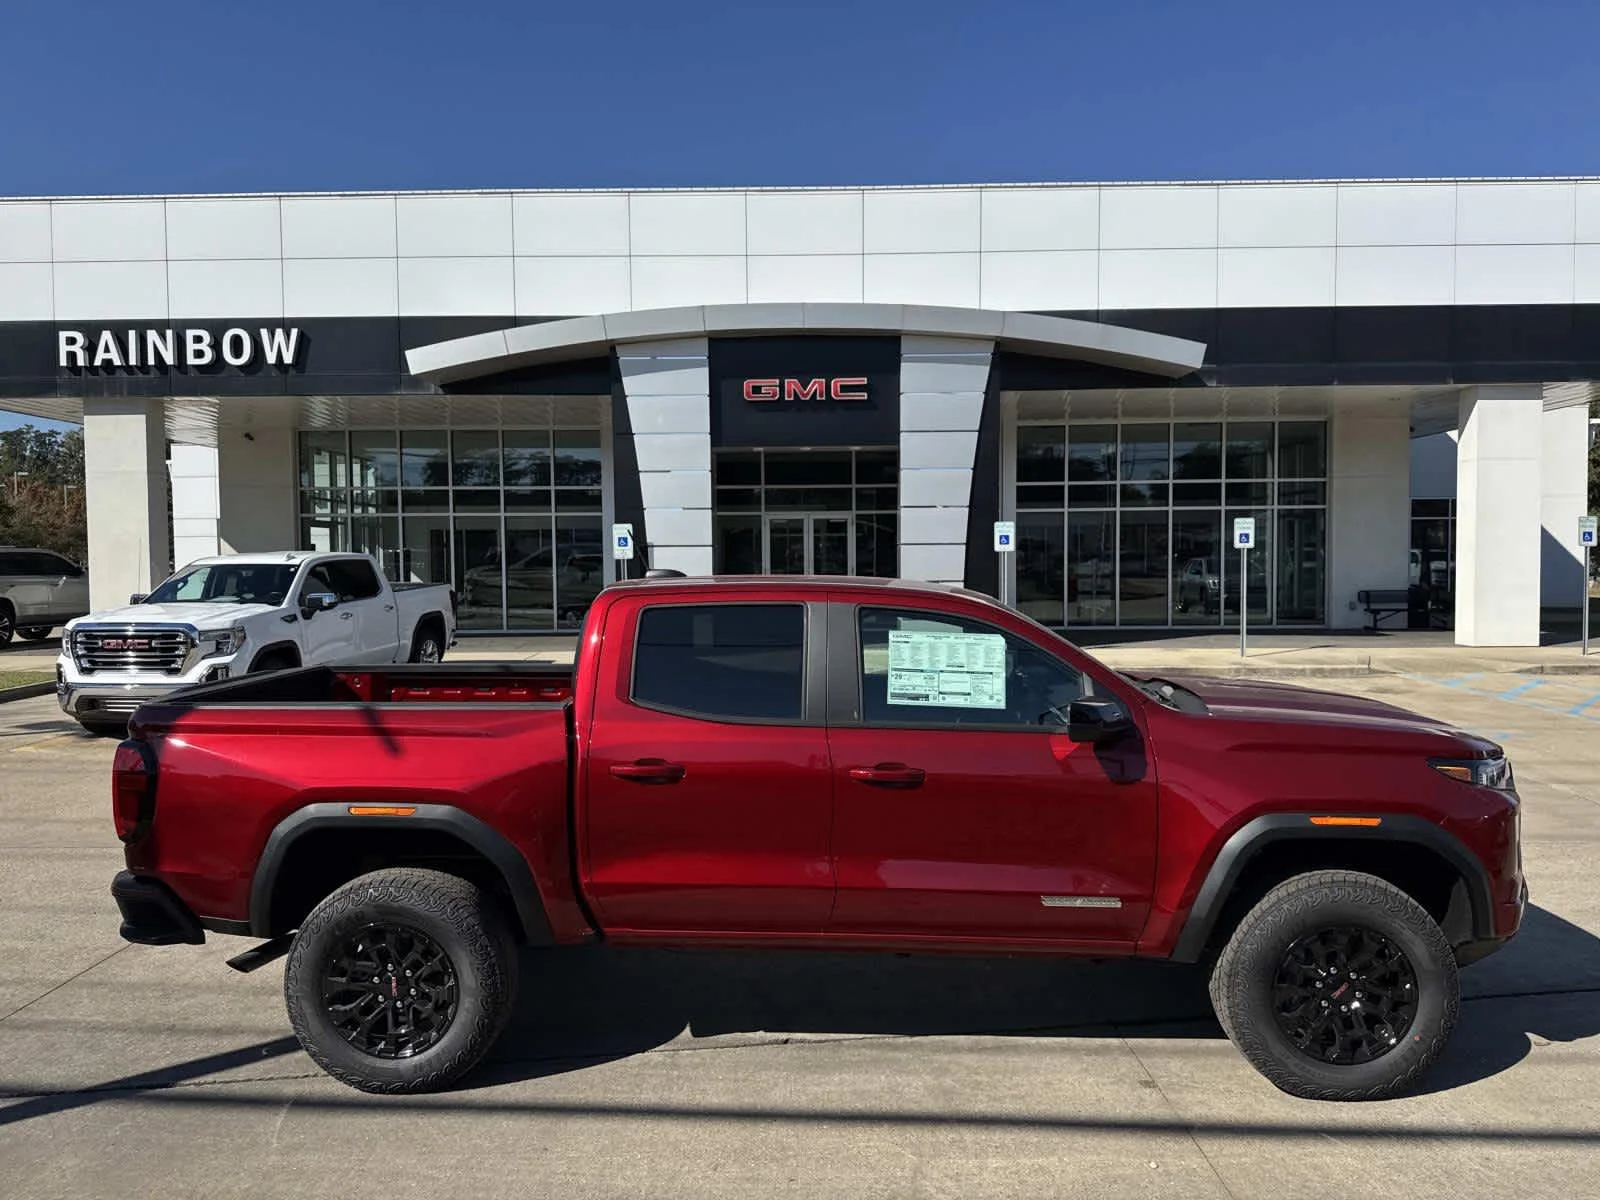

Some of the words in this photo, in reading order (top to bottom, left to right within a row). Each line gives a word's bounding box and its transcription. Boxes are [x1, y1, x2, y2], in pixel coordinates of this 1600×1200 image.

[58, 328, 299, 367] RAINBOW
[743, 377, 868, 401] GMC
[102, 639, 149, 649] GMC
